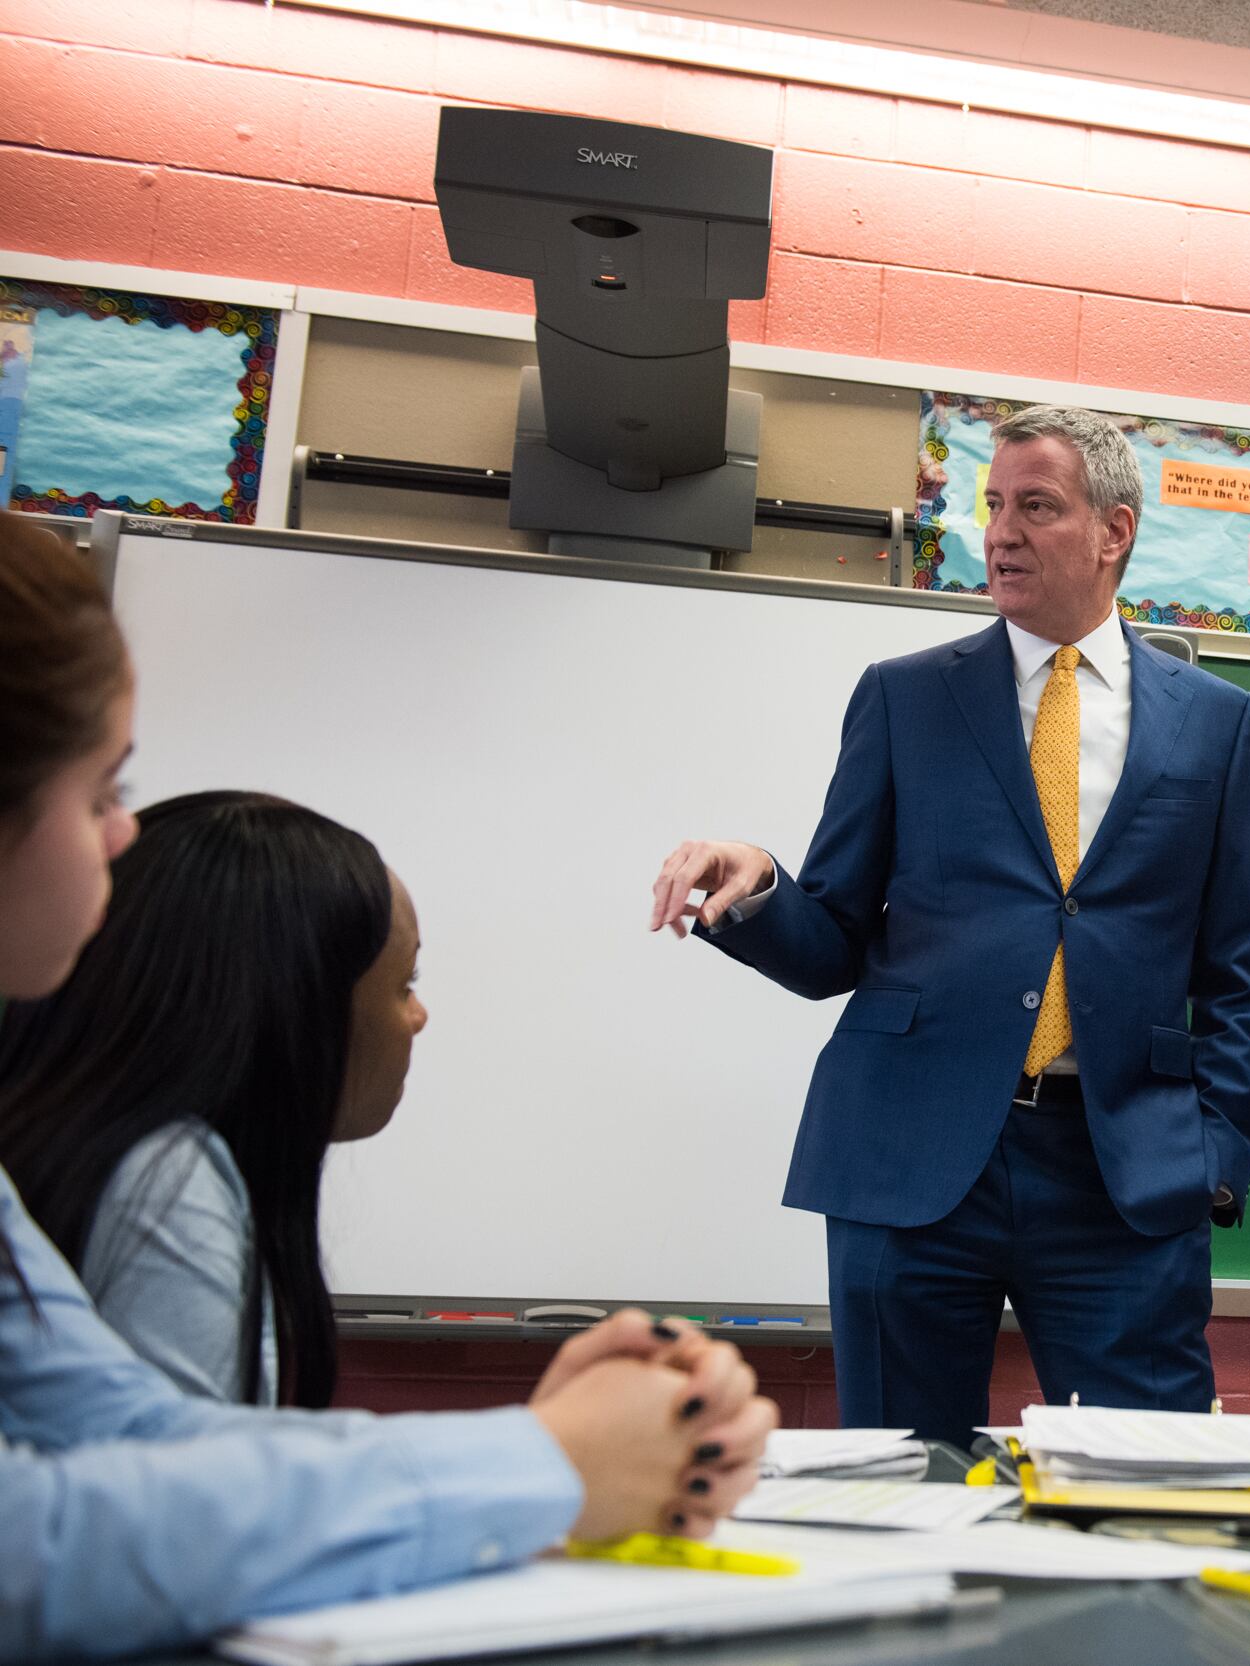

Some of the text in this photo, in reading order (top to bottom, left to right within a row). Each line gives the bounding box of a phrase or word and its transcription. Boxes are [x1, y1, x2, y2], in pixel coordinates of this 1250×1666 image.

[577, 147, 636, 169] SMART
[1168, 472, 1213, 486] “Where
[1218, 478, 1237, 489] did
[1167, 484, 1192, 495] that
[1197, 487, 1209, 497] in
[1214, 489, 1234, 500] the
